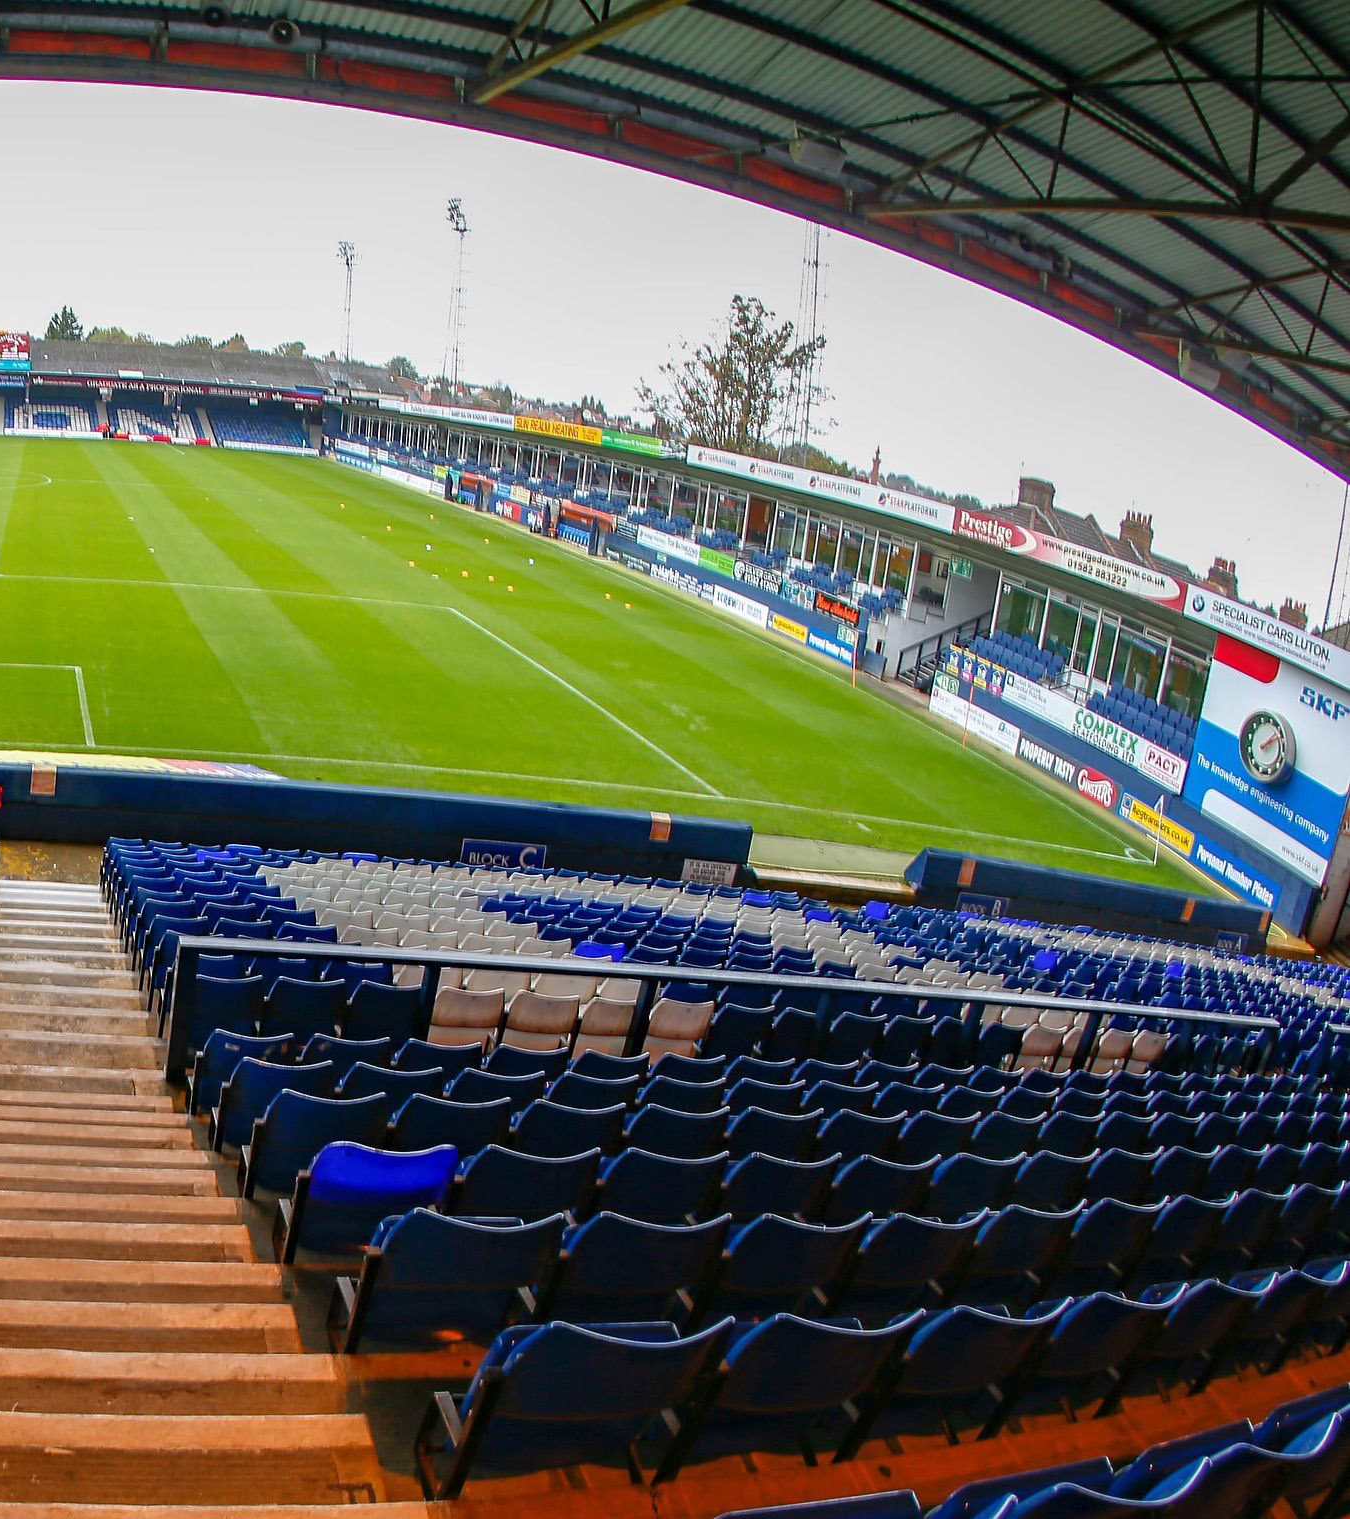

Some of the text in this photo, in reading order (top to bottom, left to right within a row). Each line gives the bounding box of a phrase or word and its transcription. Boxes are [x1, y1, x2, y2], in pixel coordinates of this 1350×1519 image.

[86, 379, 128, 390] GRADUATE
[127, 382, 140, 391] AS
[139, 383, 146, 391] A
[146, 383, 204, 395] PROFESSIONAL
[516, 418, 529, 431] SUN
[531, 419, 551, 433] REALM
[552, 423, 579, 438] HEATING
[495, 500, 513, 519] sky bet
[889, 496, 939, 519] STARPLATFORMS
[960, 510, 1013, 542] Prestige
[1042, 538, 1166, 589] www.prestigedesignww.co.uk
[1067, 558, 1127, 587] 01582 883222
[1212, 600, 1266, 633] SPECIALIST
[1266, 623, 1294, 644] CARS
[1300, 685, 1350, 721] SKF
[1072, 723, 1135, 765] SCAFFOLDING LTD
[1075, 708, 1138, 754] COMPLEX
[1019, 737, 1076, 785] PROPERLY TASTY
[1148, 750, 1178, 777] PACT
[1197, 752, 1330, 845] The knowledge engineering company
[469, 846, 538, 869] BLOCK C
[1196, 844, 1275, 907] Personal Number Plates
[992, 900, 1002, 916] B
